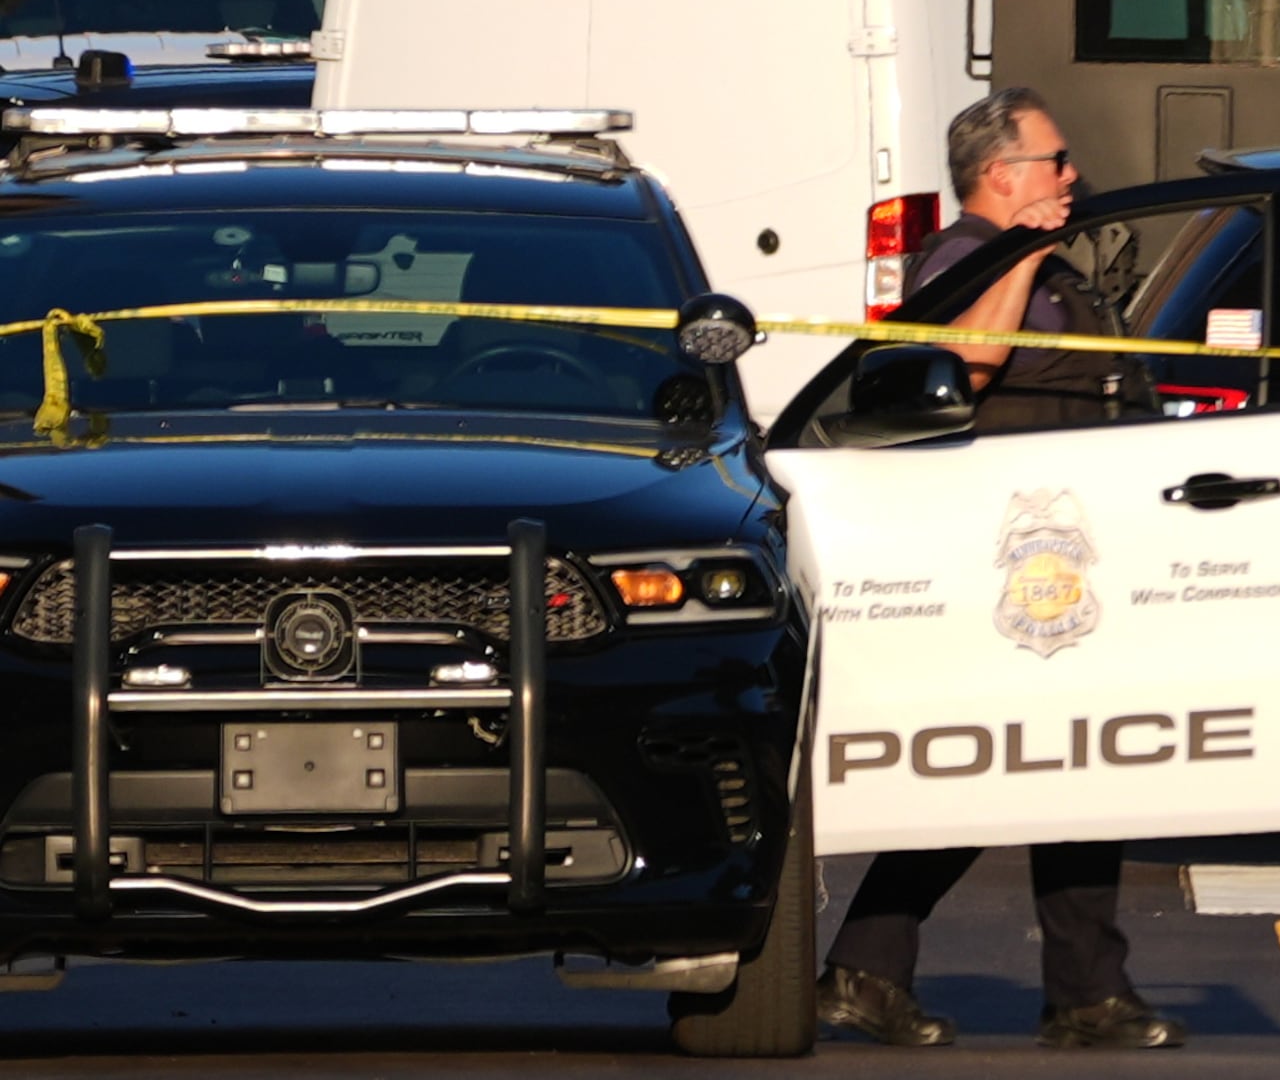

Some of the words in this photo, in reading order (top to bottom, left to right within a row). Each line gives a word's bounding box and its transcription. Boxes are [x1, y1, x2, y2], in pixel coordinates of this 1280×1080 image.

[1170, 563, 1190, 579] TO
[1197, 561, 1250, 577] SERVE
[833, 581, 854, 597] TO
[859, 579, 932, 596] PROTECT
[1131, 589, 1176, 605] WITH
[820, 606, 862, 622] WITH
[867, 602, 946, 620] COURAGE
[828, 707, 1256, 786] POLICE
